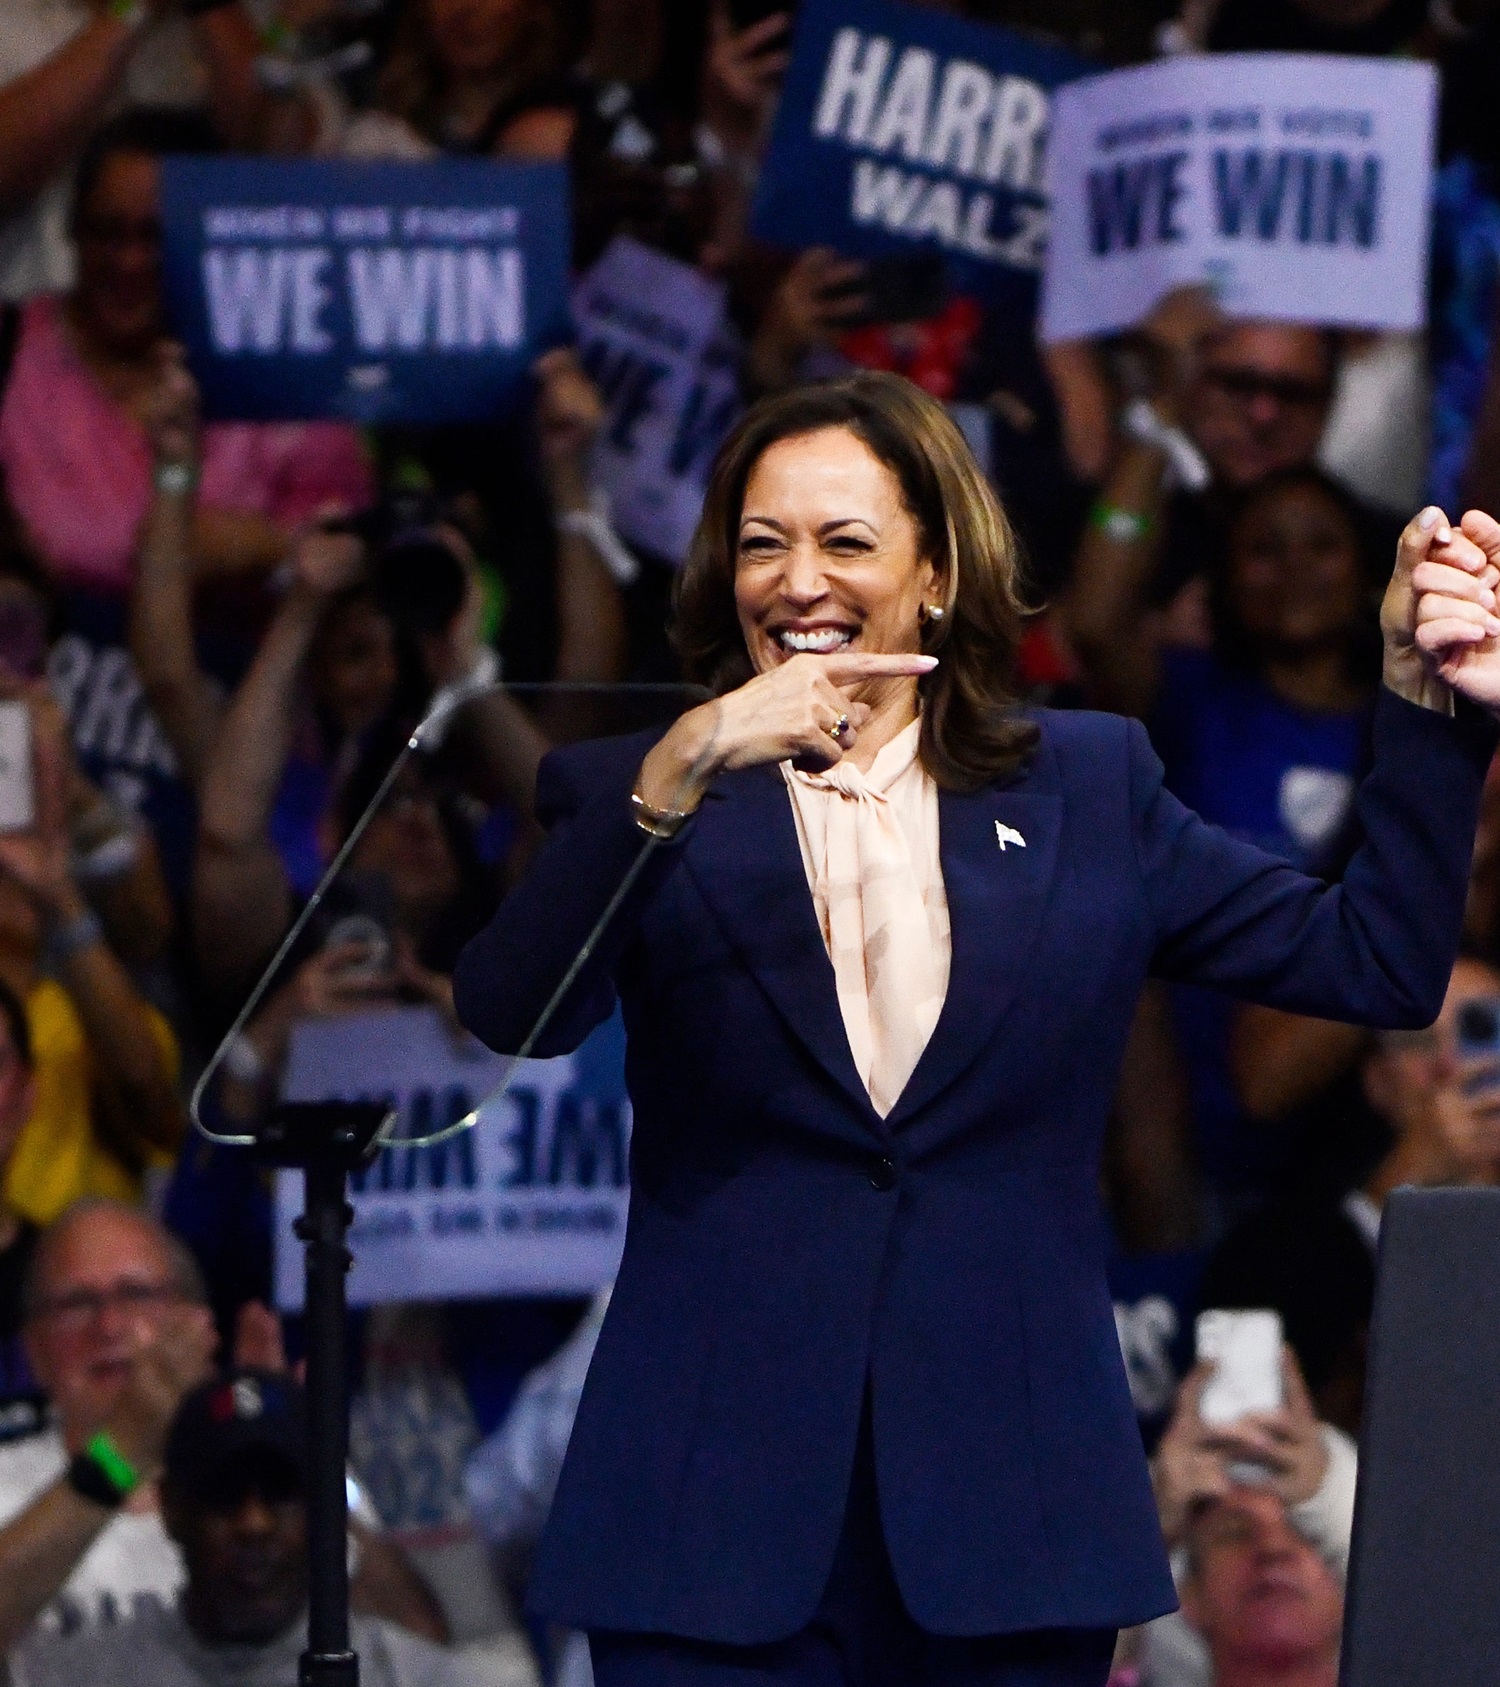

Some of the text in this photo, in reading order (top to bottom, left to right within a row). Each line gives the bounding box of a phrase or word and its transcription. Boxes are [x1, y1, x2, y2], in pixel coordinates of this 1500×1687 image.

[811, 27, 1048, 192] HARR
[852, 158, 1048, 270] WALZ
[1087, 146, 1381, 255] WE WIN
[204, 248, 525, 352] WE WIN
